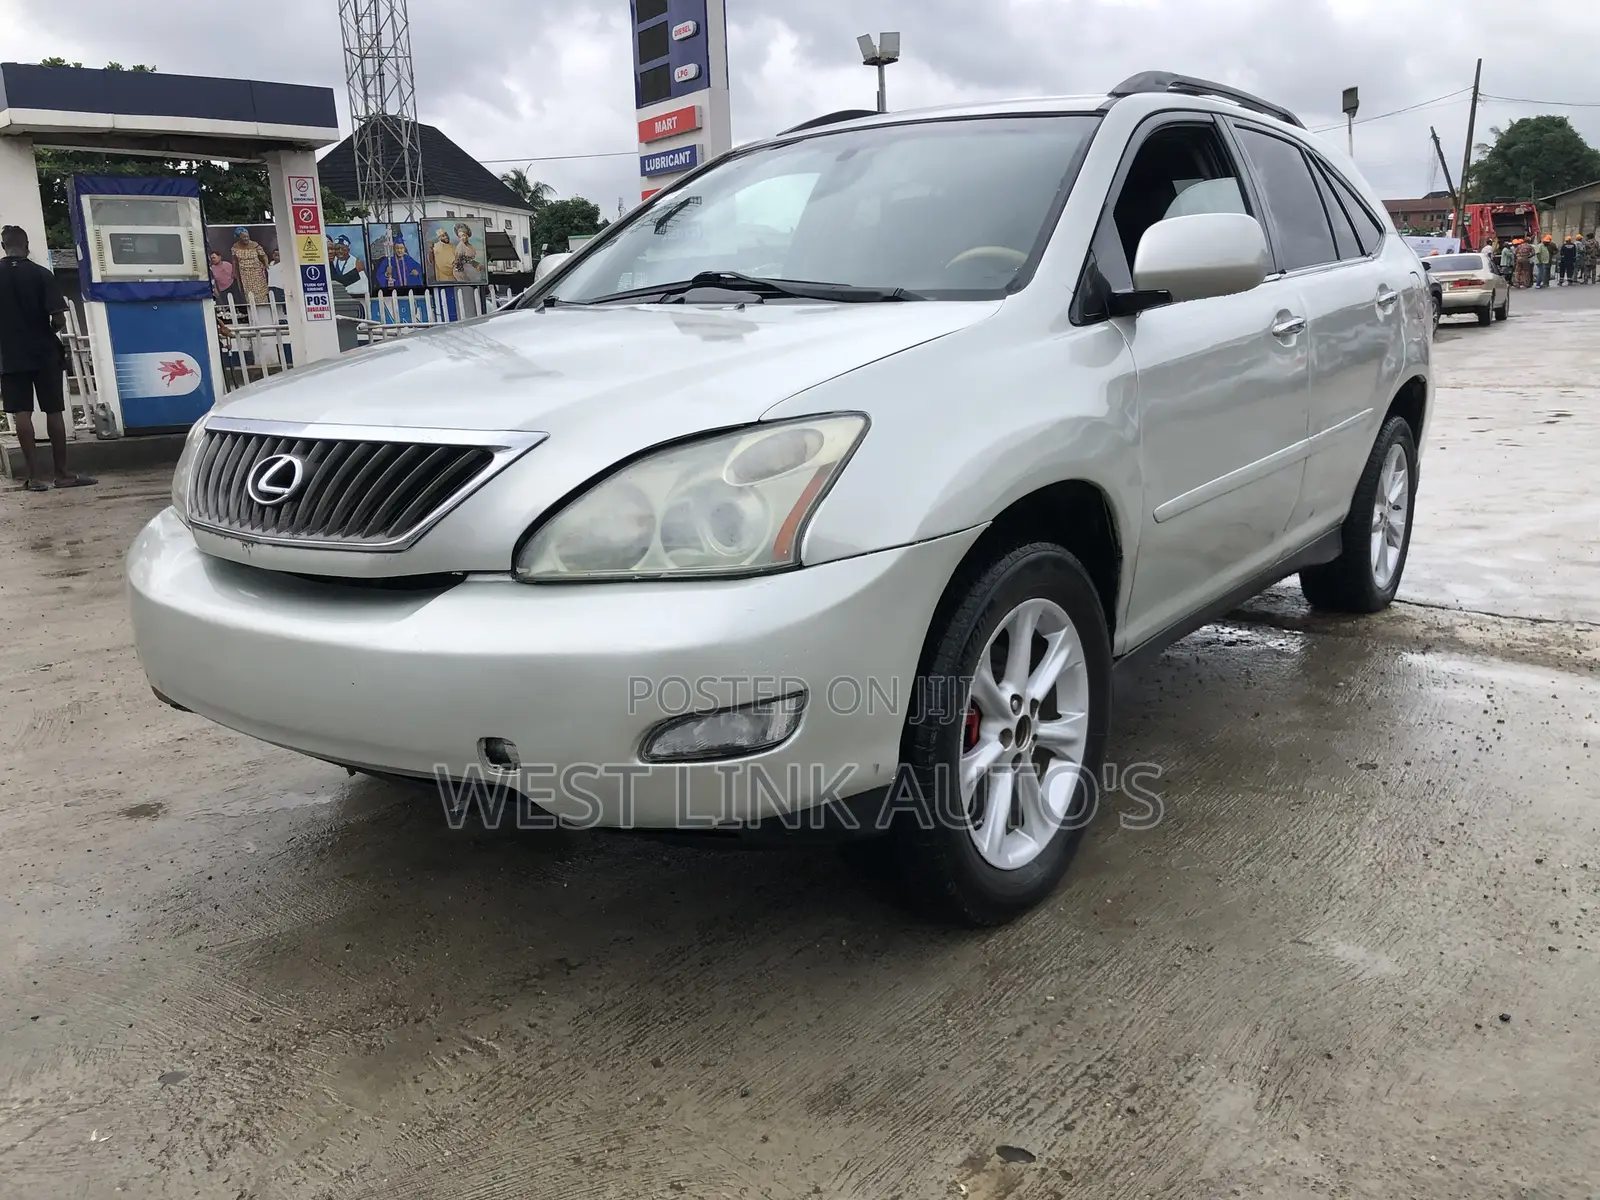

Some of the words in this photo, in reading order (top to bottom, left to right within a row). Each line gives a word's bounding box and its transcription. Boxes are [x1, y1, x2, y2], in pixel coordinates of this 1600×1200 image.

[674, 25, 691, 37] DIESEL
[677, 69, 688, 79] LPG
[654, 116, 678, 134] MART
[645, 150, 691, 171] LUBRICANT
[307, 296, 327, 305] POS
